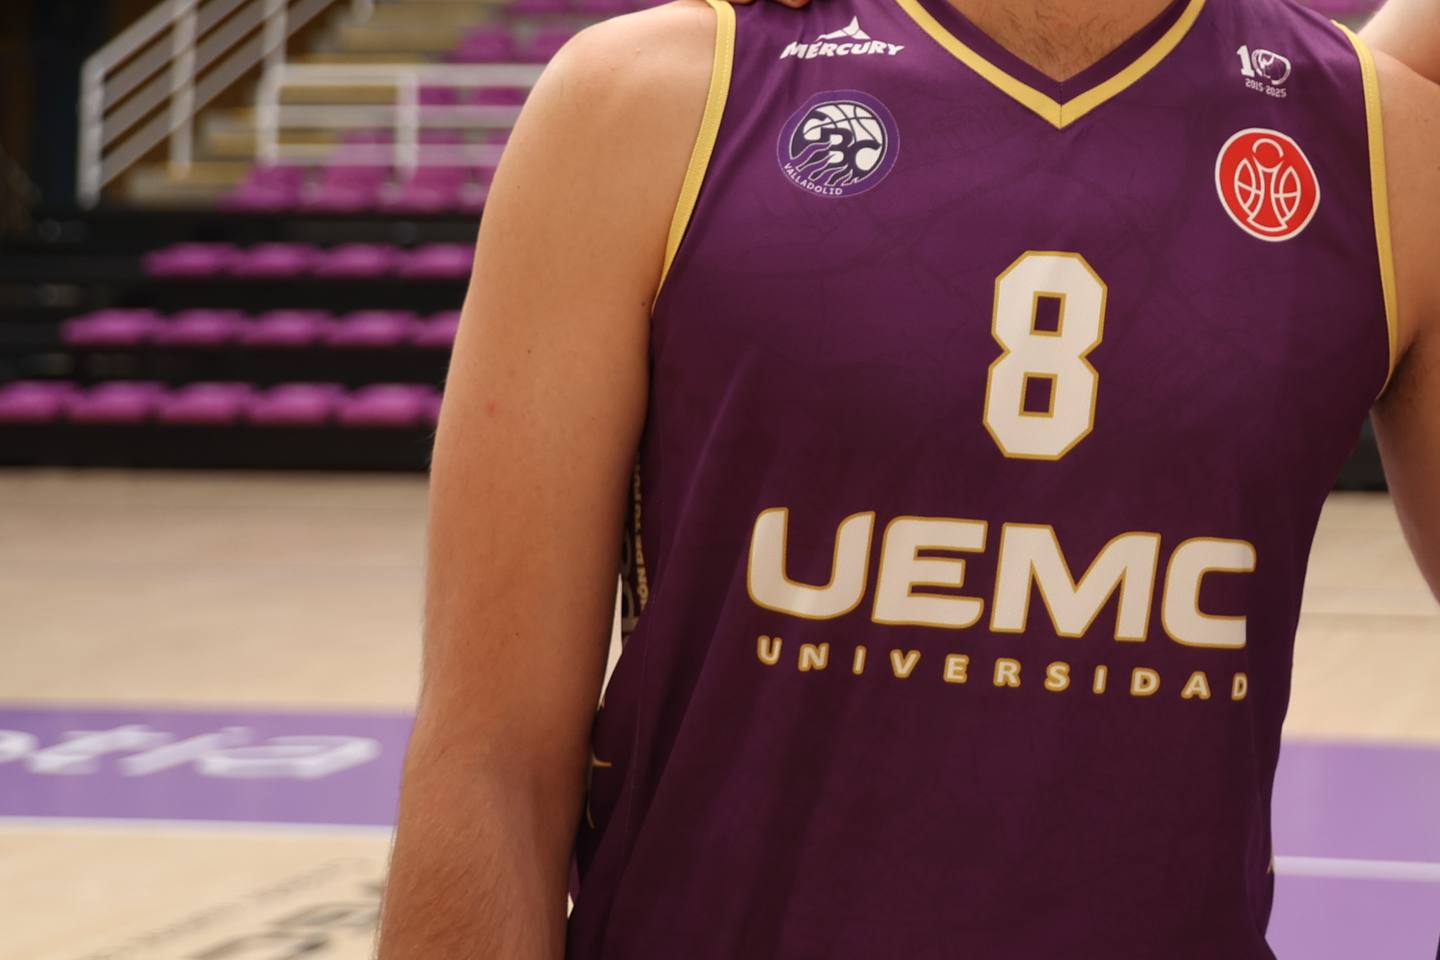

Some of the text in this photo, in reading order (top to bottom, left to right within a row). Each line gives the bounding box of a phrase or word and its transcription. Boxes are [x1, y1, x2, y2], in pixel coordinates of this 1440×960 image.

[779, 40, 905, 60] MERCURY
[783, 161, 843, 196] VALLADOLID
[982, 250, 1108, 461] 8
[746, 506, 1257, 650] UEMC
[755, 634, 1249, 702] UNIVERSIDAD
